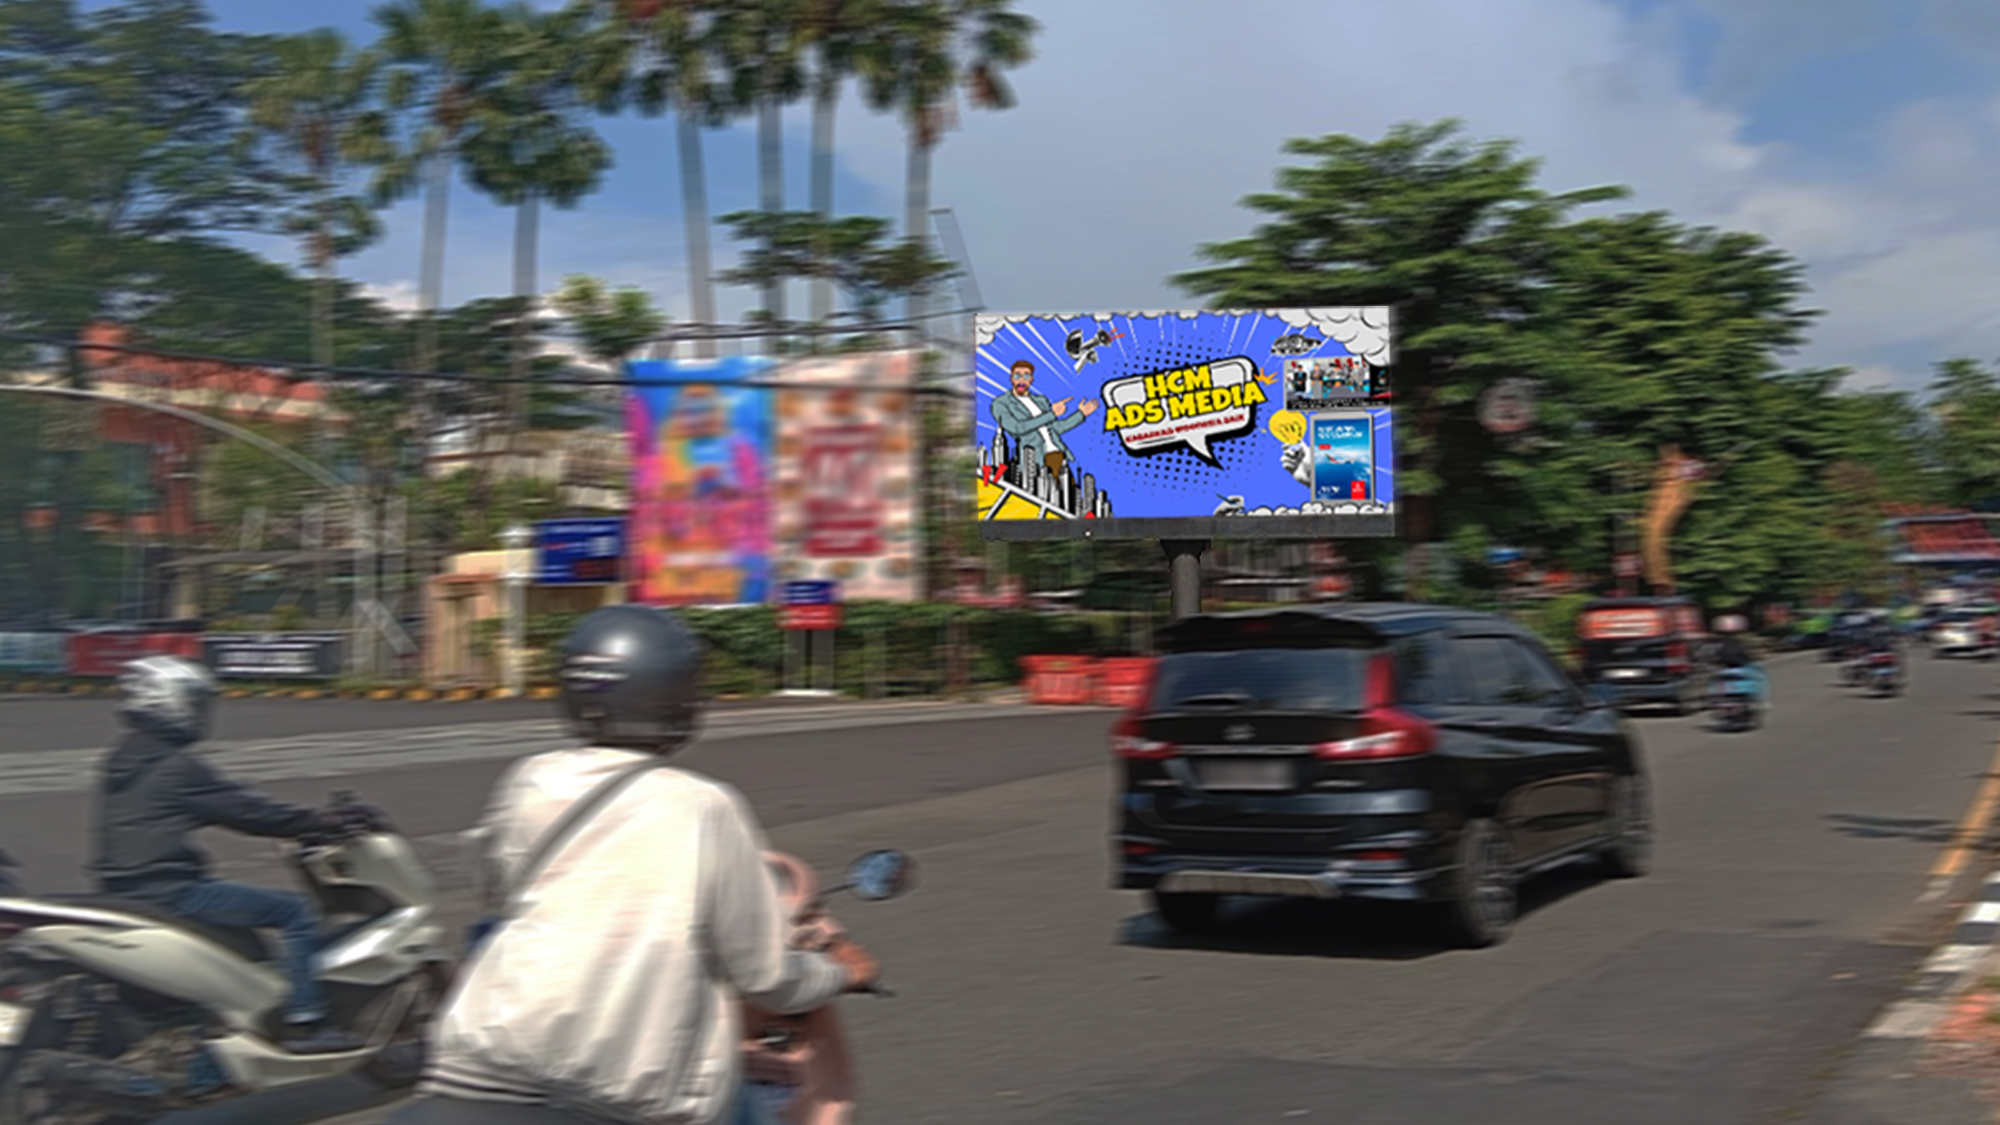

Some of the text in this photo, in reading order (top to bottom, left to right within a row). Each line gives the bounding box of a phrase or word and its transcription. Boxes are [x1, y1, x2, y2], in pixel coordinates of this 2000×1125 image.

[1144, 365, 1212, 398] HCM
[1105, 381, 1267, 430] ADS MEDIA
